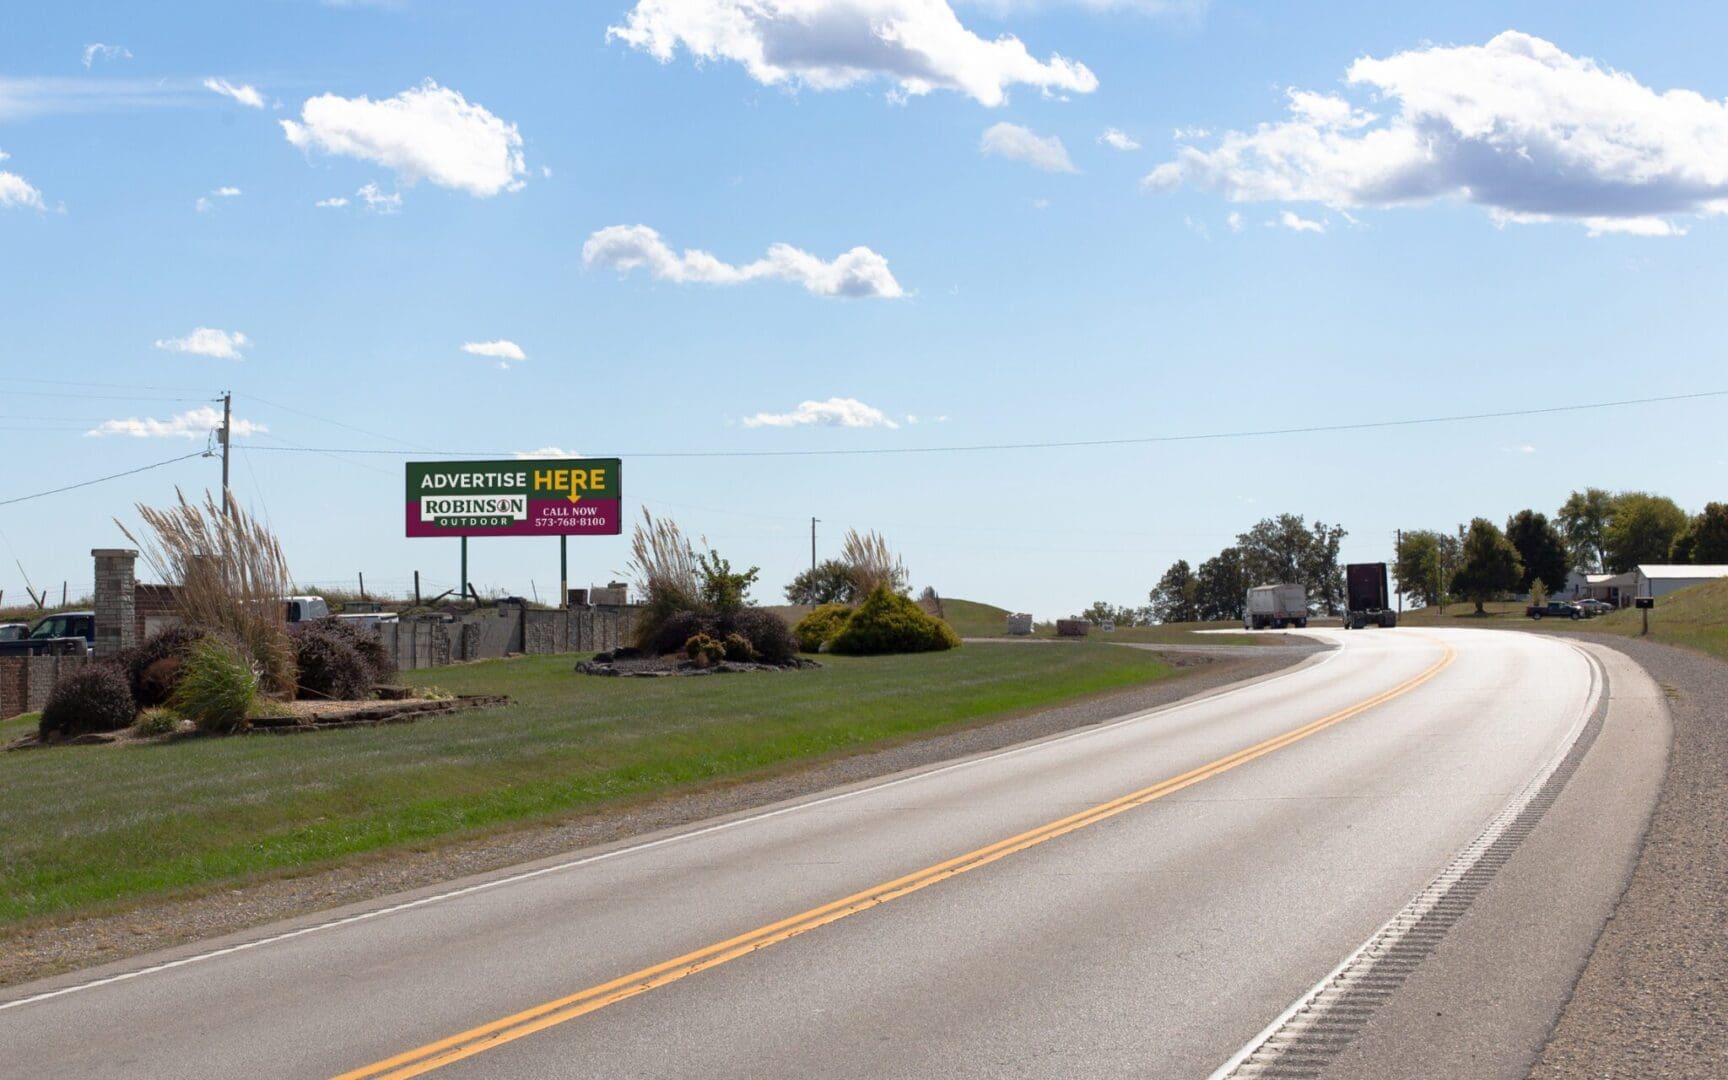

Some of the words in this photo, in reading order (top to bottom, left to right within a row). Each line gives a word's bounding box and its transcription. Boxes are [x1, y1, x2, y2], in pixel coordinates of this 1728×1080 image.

[421, 472, 527, 489] ADVERTISE
[534, 469, 605, 491] HERE
[425, 498, 523, 514] ROBINSON
[543, 507, 569, 516] CALL
[572, 507, 598, 516] NOW
[440, 517, 508, 526] OUTDOOR
[535, 517, 605, 527] 573-768-8100
